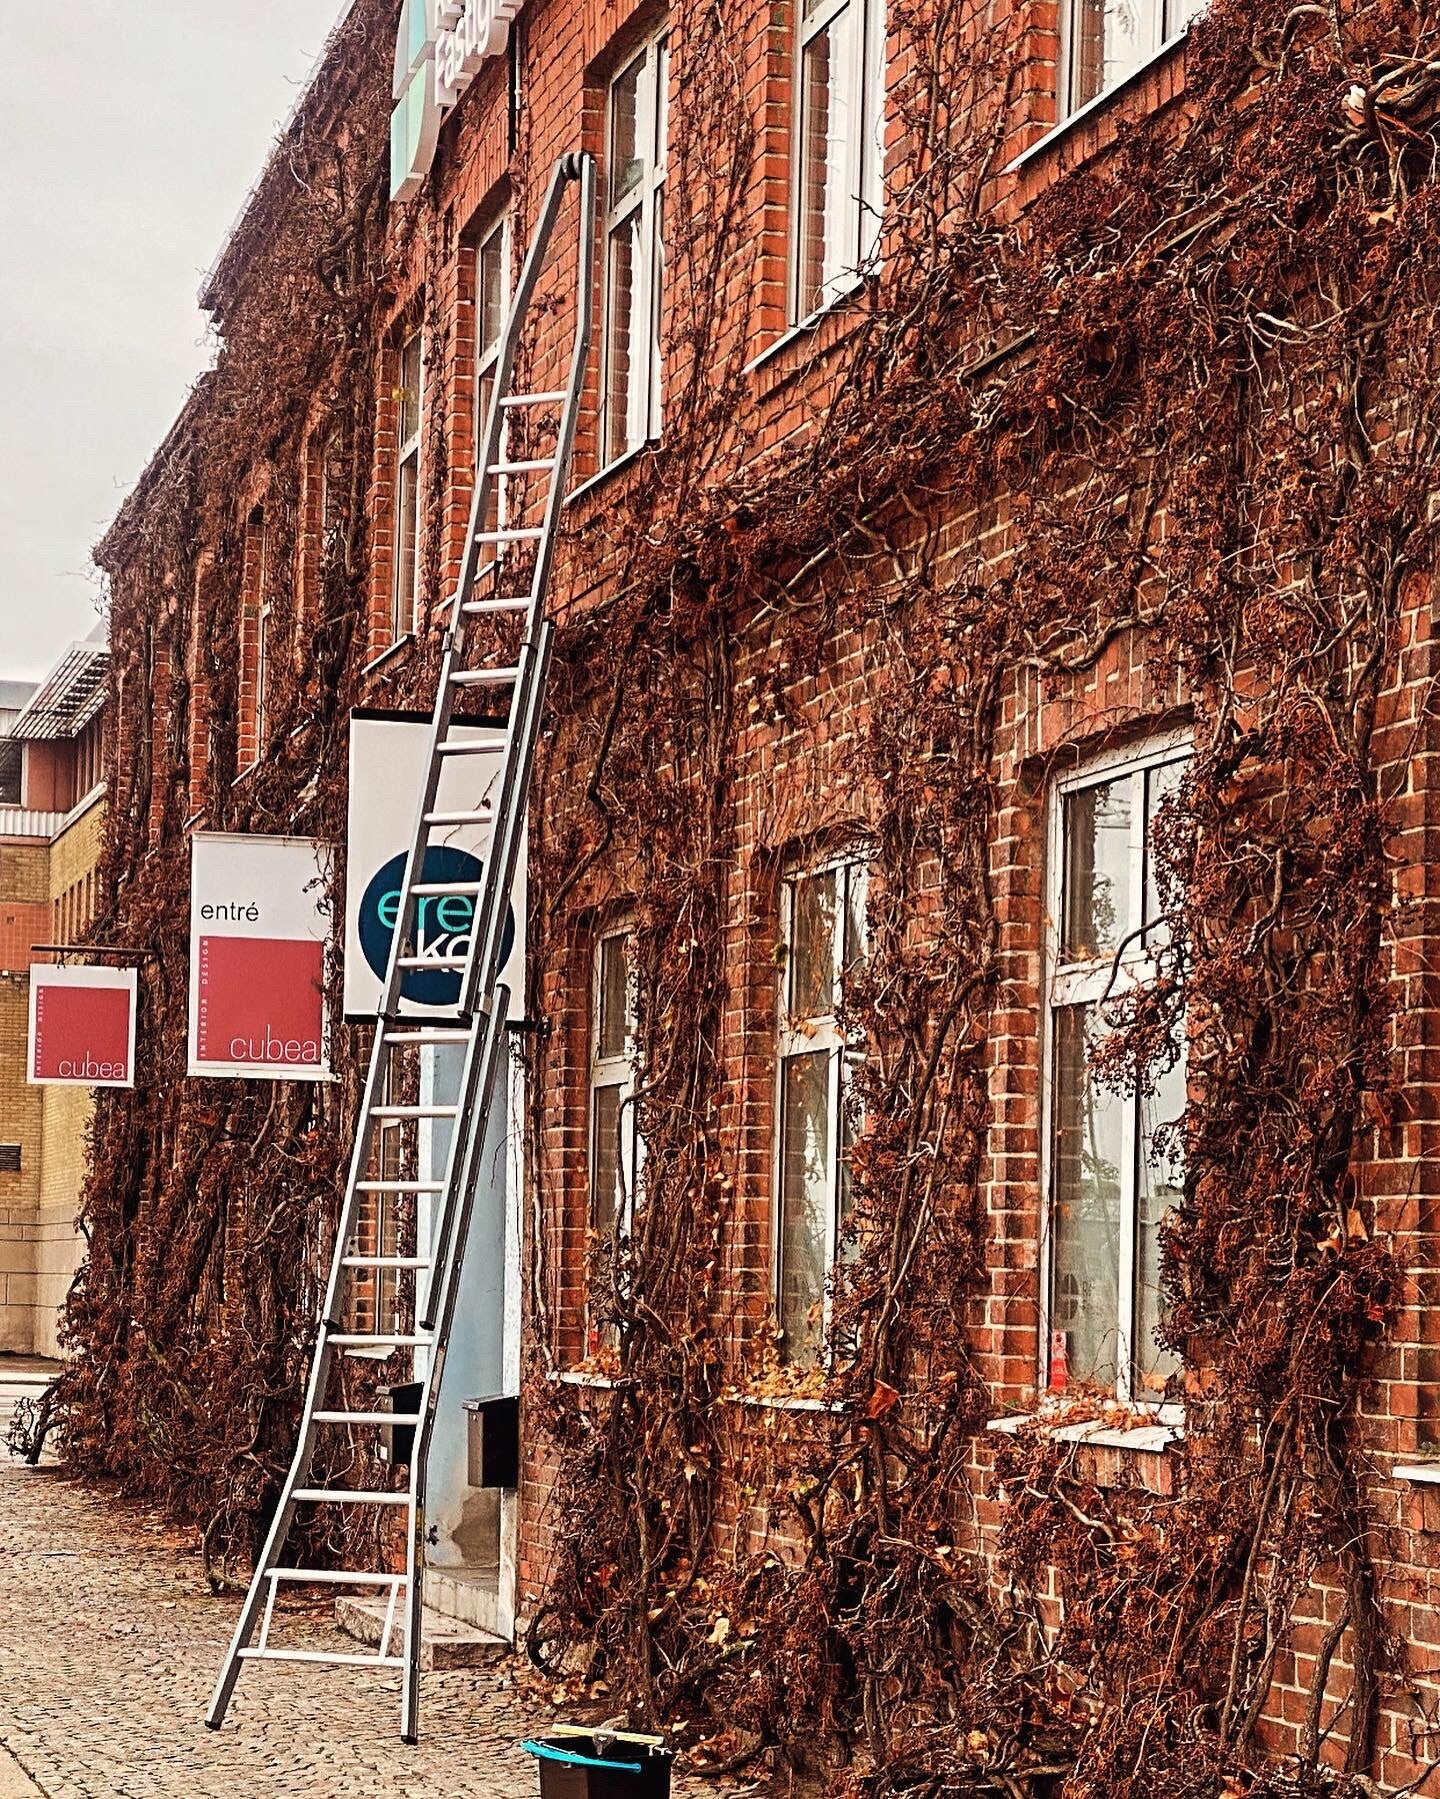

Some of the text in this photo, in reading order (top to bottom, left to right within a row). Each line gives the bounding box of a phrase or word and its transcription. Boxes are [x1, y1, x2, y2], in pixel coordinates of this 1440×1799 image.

[200, 902, 259, 922] entré
[200, 998, 208, 1057] INTERIOR
[230, 1024, 319, 1062] cubea
[58, 1050, 125, 1079] cubea
